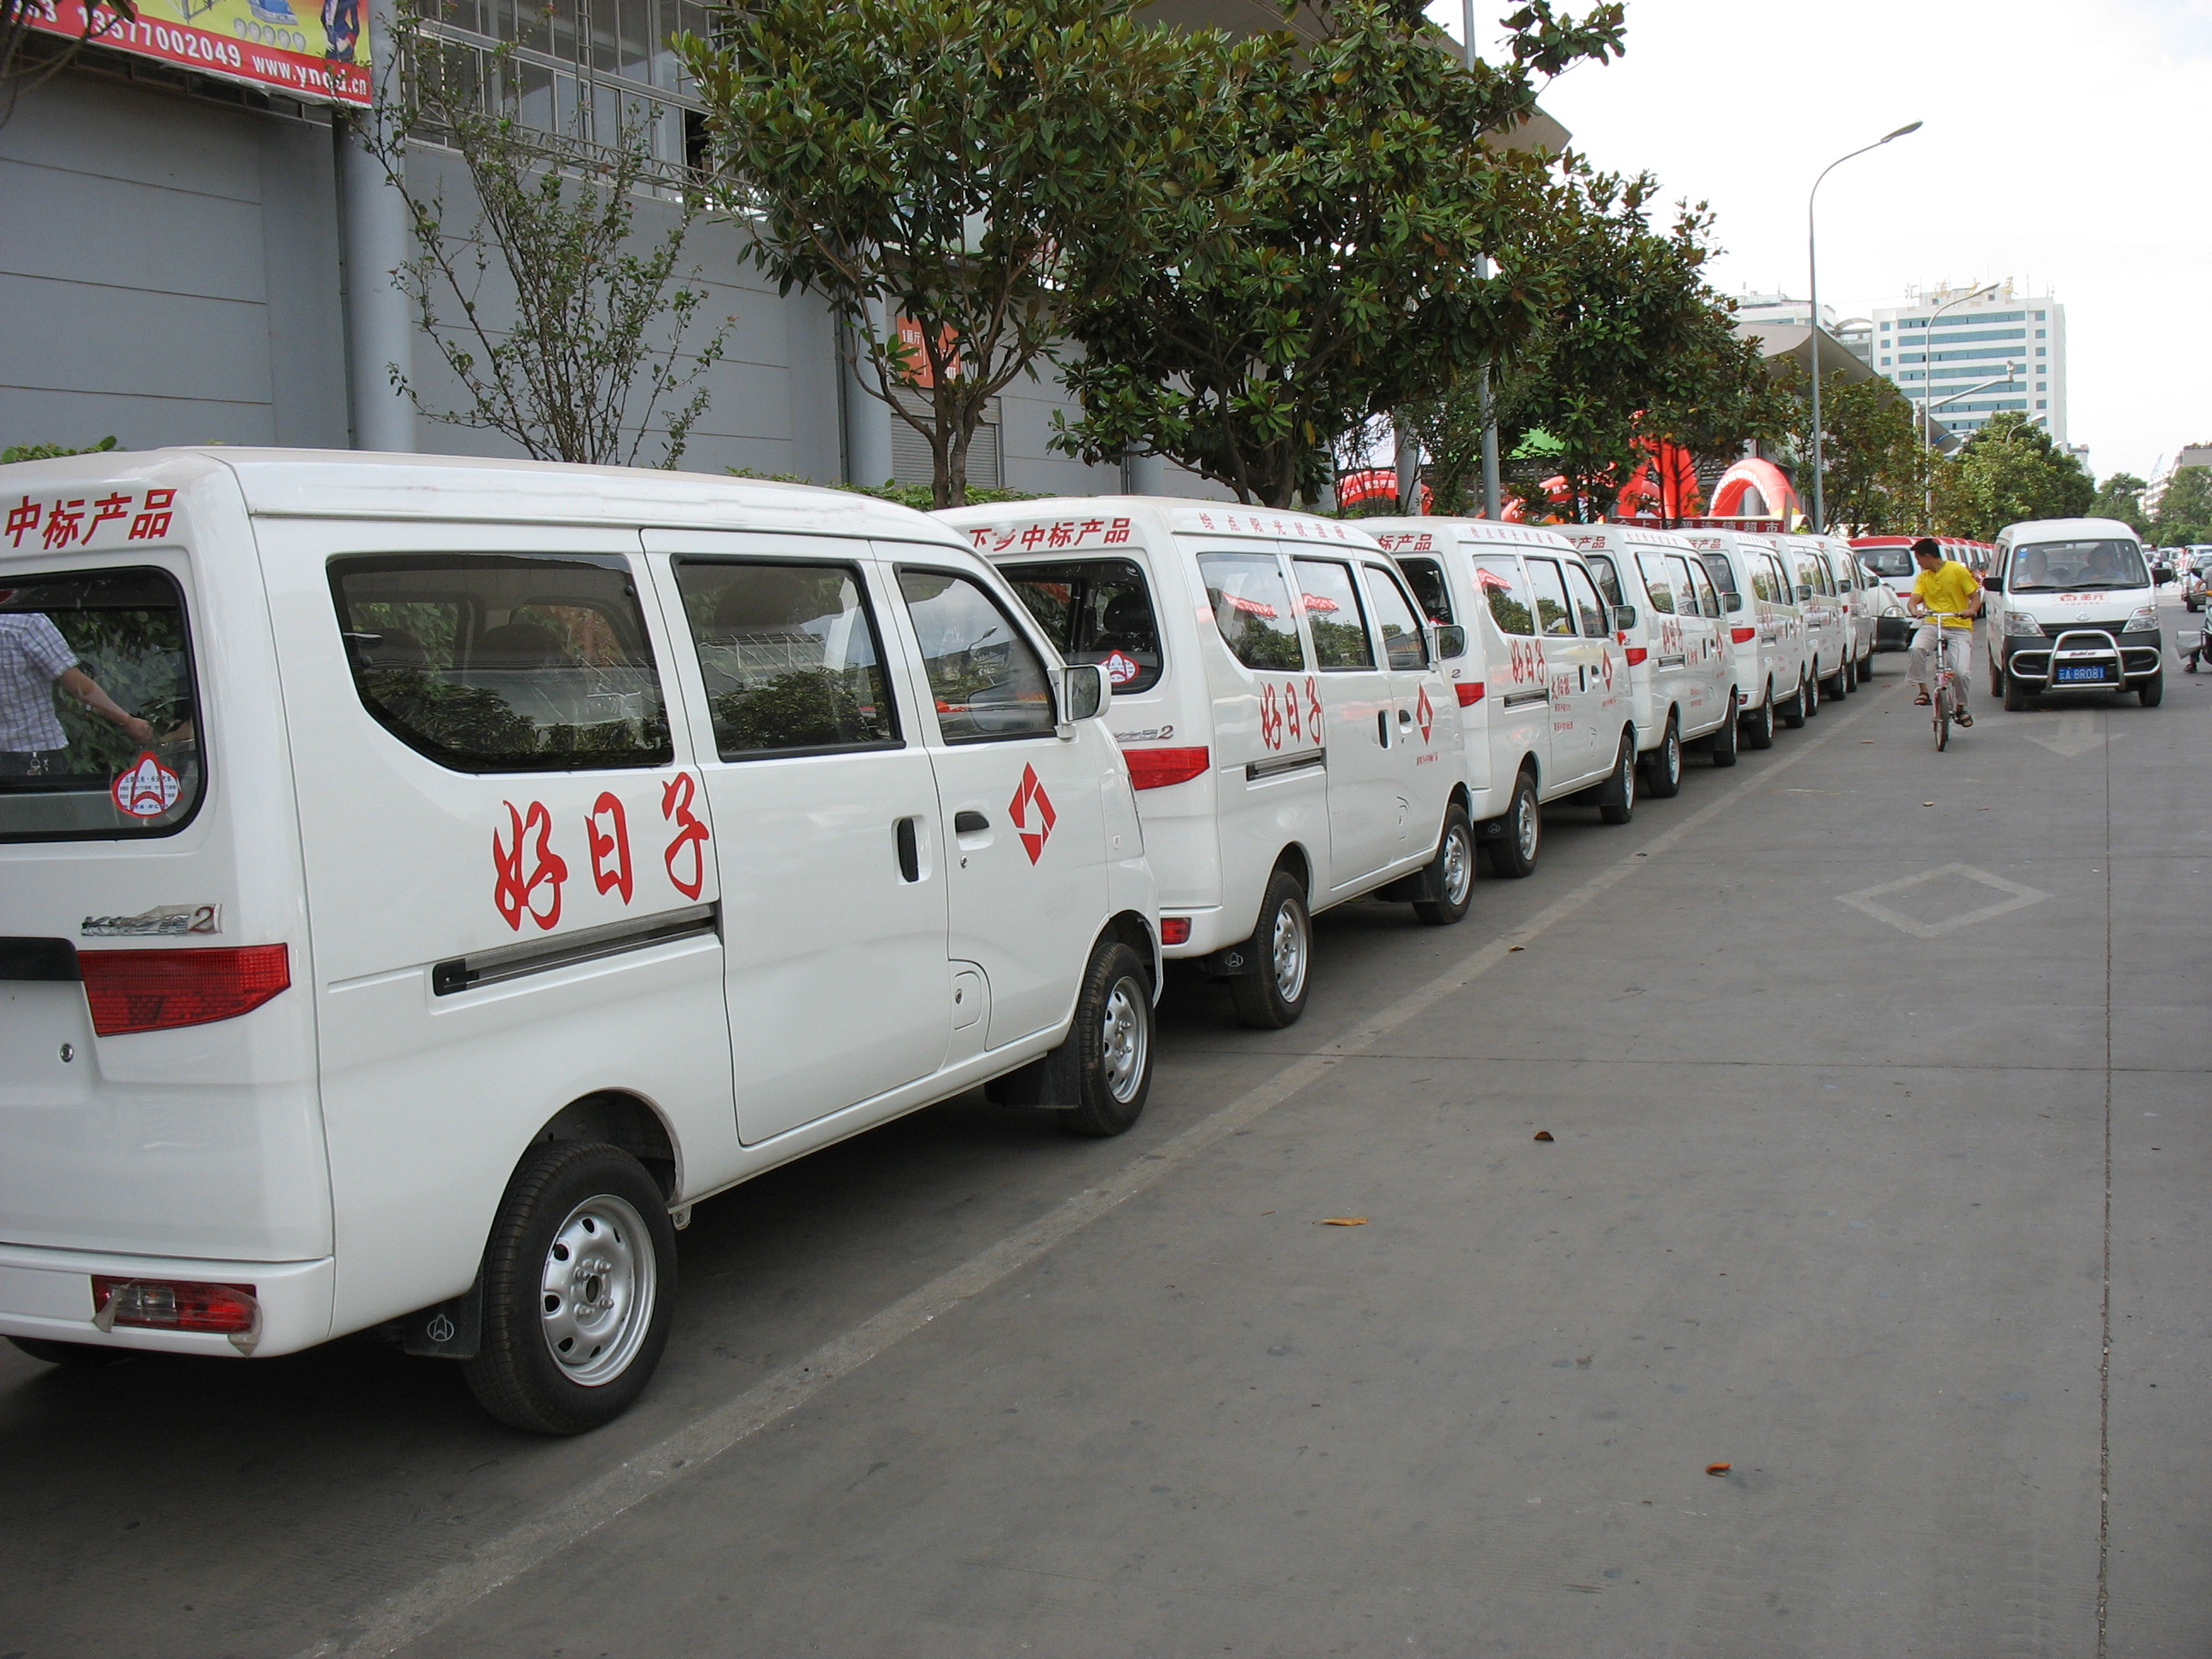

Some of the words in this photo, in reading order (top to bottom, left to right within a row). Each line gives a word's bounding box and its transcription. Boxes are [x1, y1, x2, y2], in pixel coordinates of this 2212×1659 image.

[77, 6, 242, 68] 13577002049
[4, 488, 178, 550] 中标产品
[1511, 638, 1545, 685] 好日子
[1260, 676, 1321, 751] 好日子
[492, 771, 710, 932] 好日子
